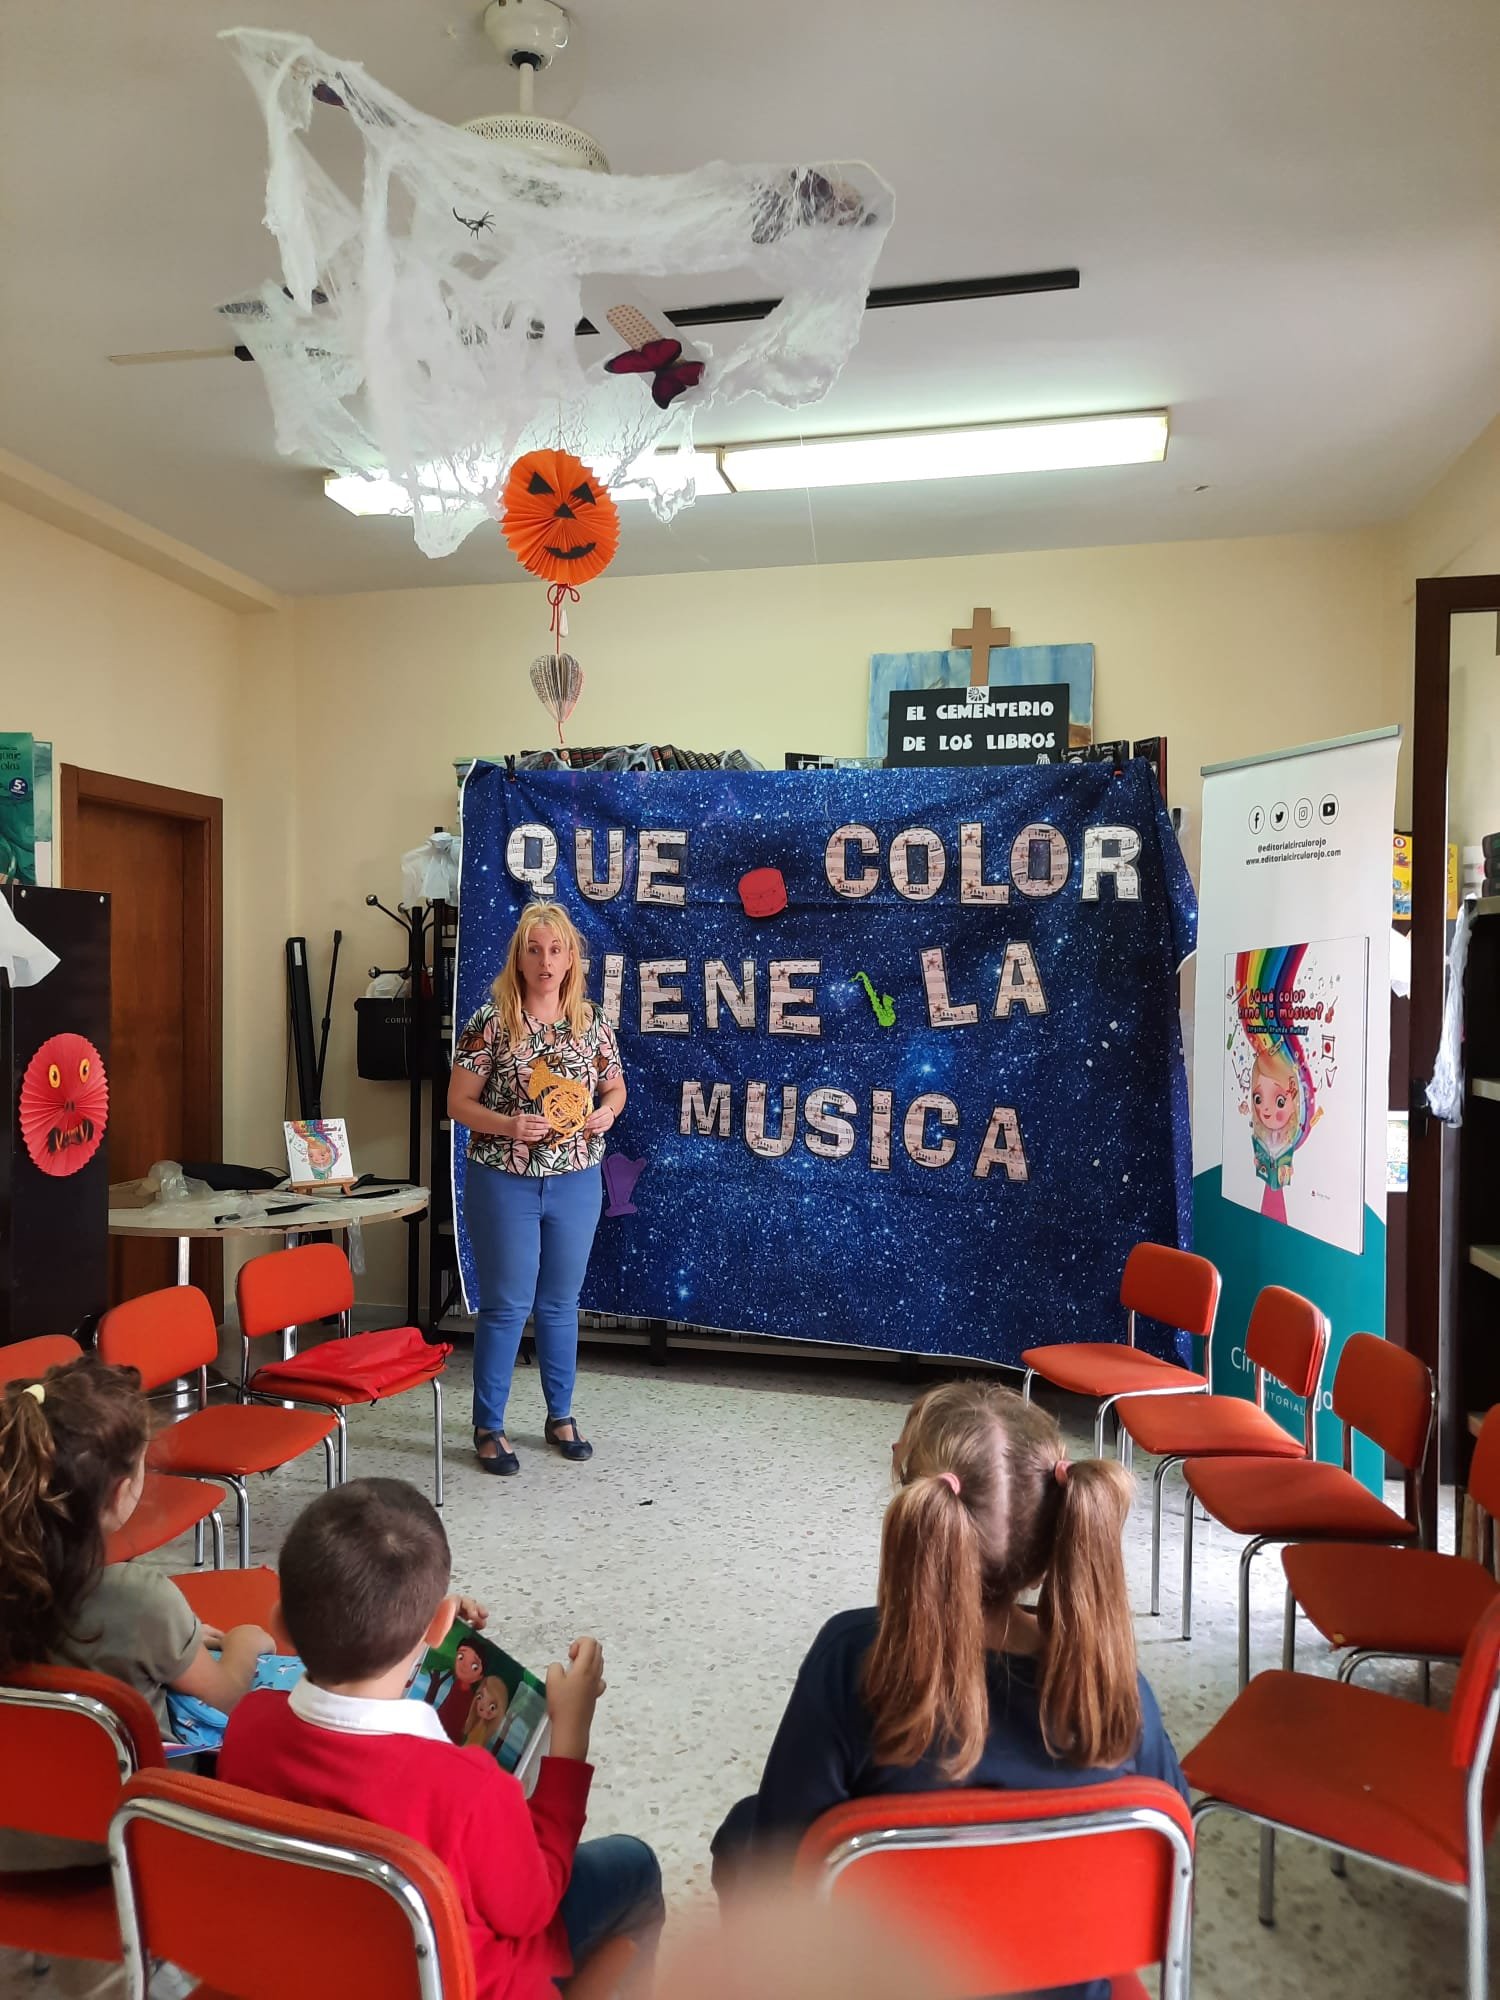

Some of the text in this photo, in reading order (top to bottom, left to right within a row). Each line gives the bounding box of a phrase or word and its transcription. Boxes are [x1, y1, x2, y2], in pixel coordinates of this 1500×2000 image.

[906, 701, 1055, 722] EL CEMENTERIO
[903, 732, 1056, 752] DE LOS LIBROS
[1257, 838, 1327, 853] @editorialcirculorojo
[505, 822, 1142, 907] QUE COLOR
[1245, 848, 1341, 865] www.editorialcirculorojo.com
[582, 940, 1049, 1036] IENE LA
[1249, 988, 1305, 1004] ¿Qué color
[1265, 1005, 1275, 1019] la
[1279, 1002, 1324, 1020] música?
[680, 1080, 1030, 1182] MUSICA
